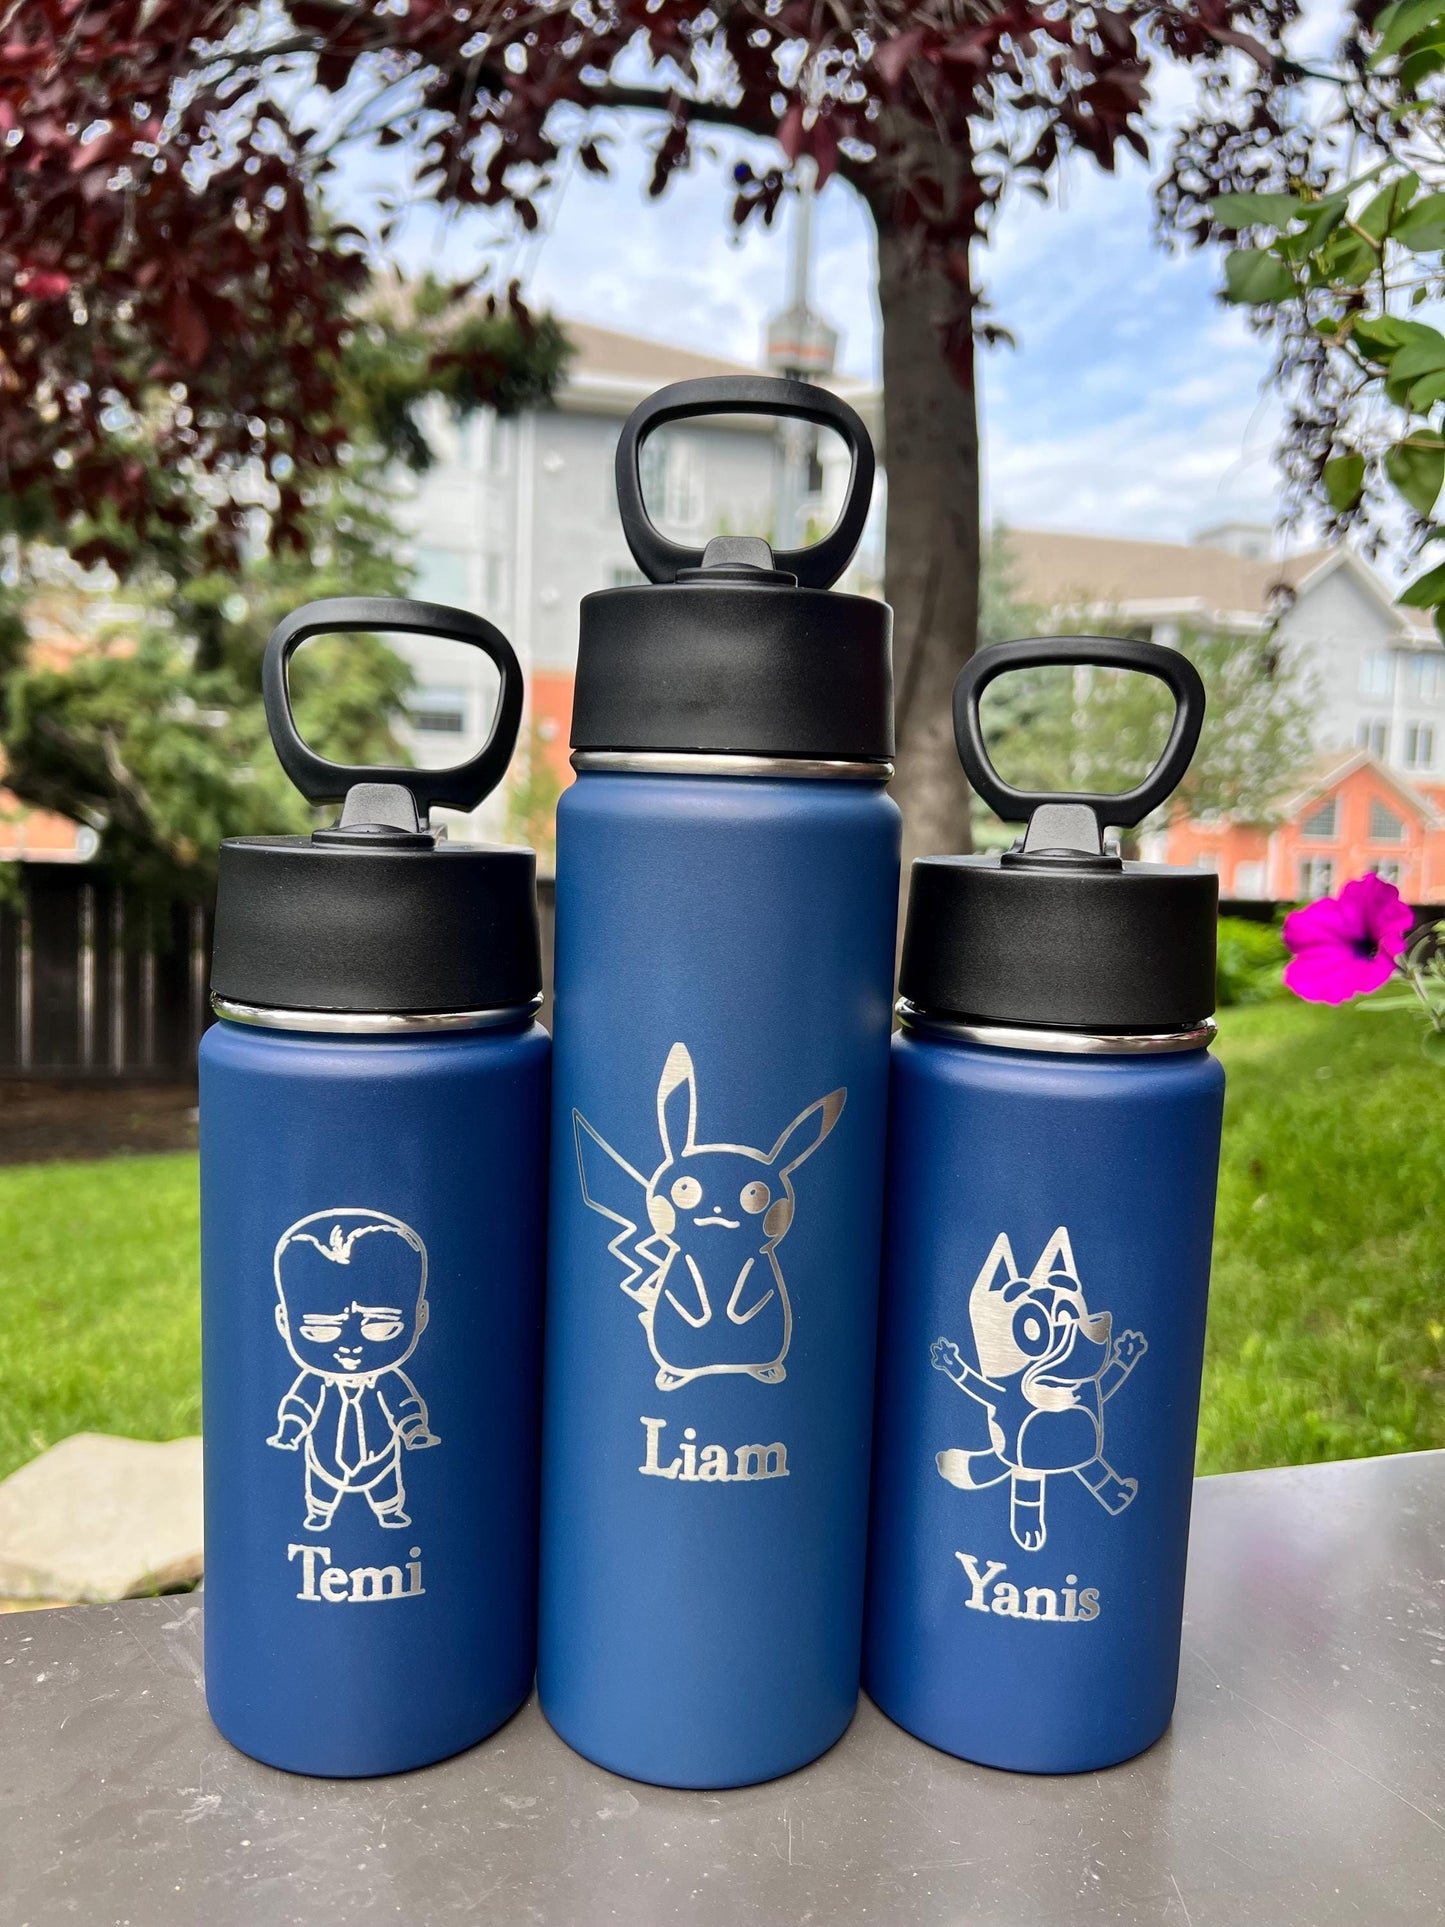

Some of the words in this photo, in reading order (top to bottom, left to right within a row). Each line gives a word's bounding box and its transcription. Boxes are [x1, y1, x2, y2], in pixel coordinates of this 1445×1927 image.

[637, 1415, 790, 1483] Liam
[287, 1543, 426, 1604] Temi
[954, 1551, 1101, 1623] Yanis
